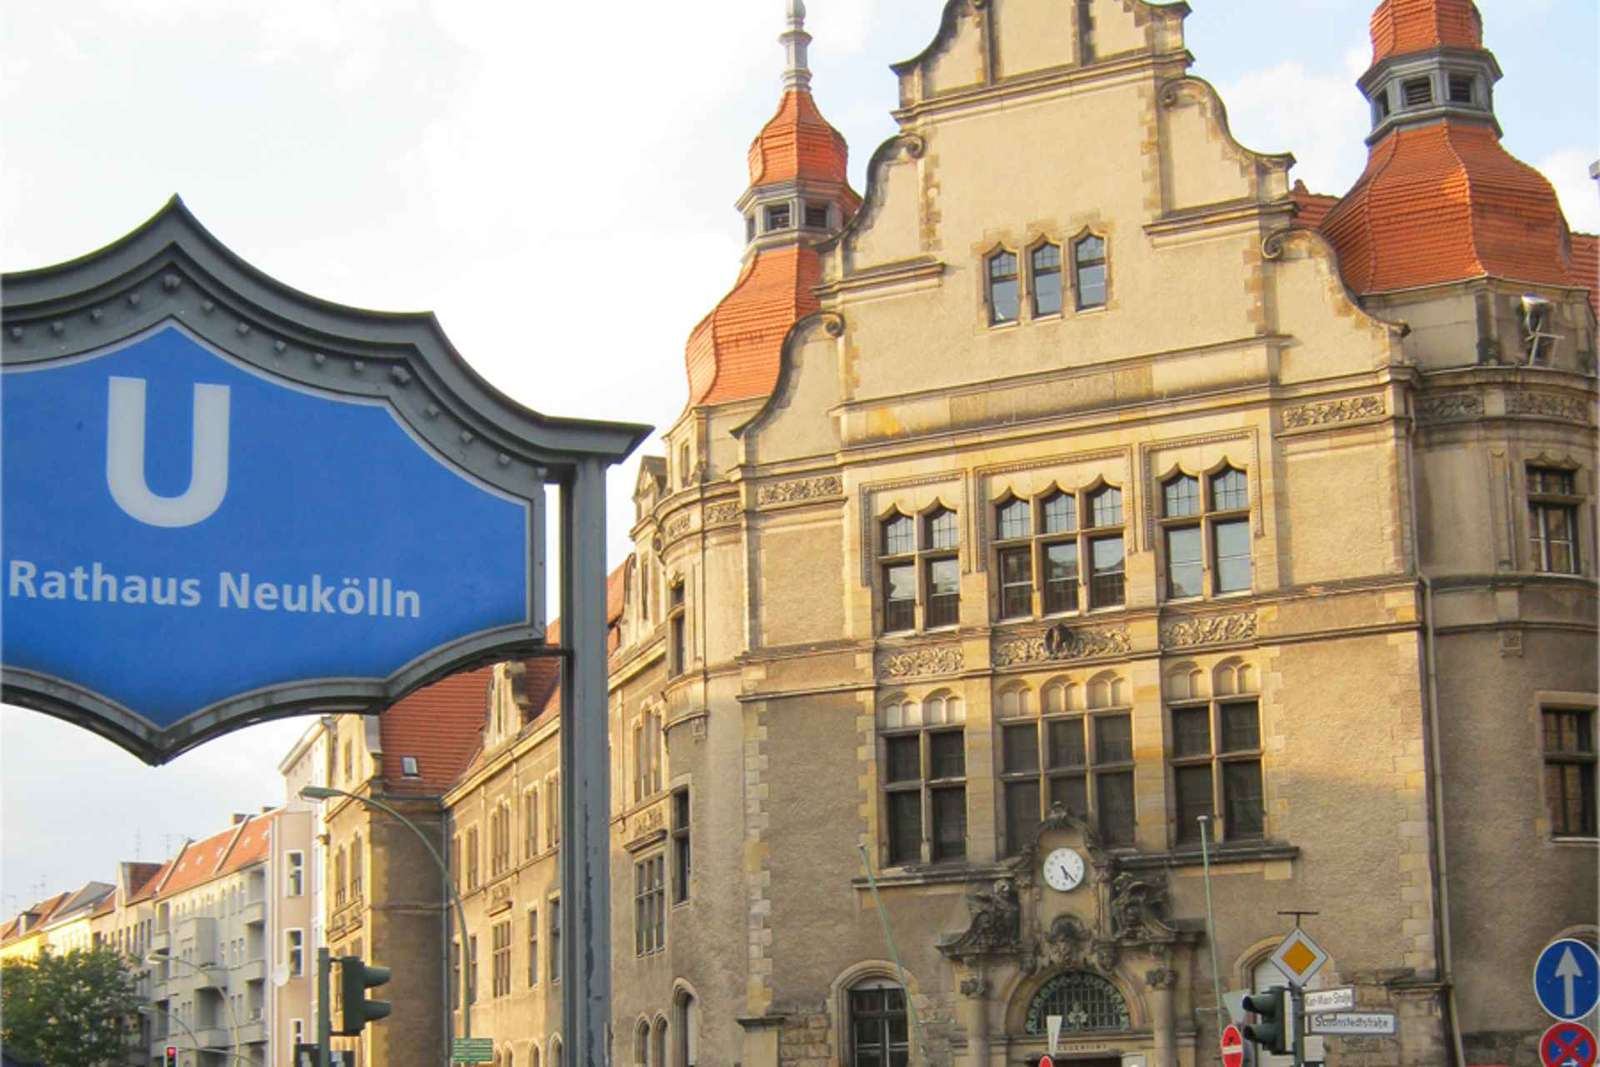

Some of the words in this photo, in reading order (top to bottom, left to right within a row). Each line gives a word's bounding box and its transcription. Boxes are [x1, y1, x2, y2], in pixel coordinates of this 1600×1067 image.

[106, 375, 231, 528] U
[8, 559, 201, 607] Rathaus
[218, 572, 421, 619] Neukölln
